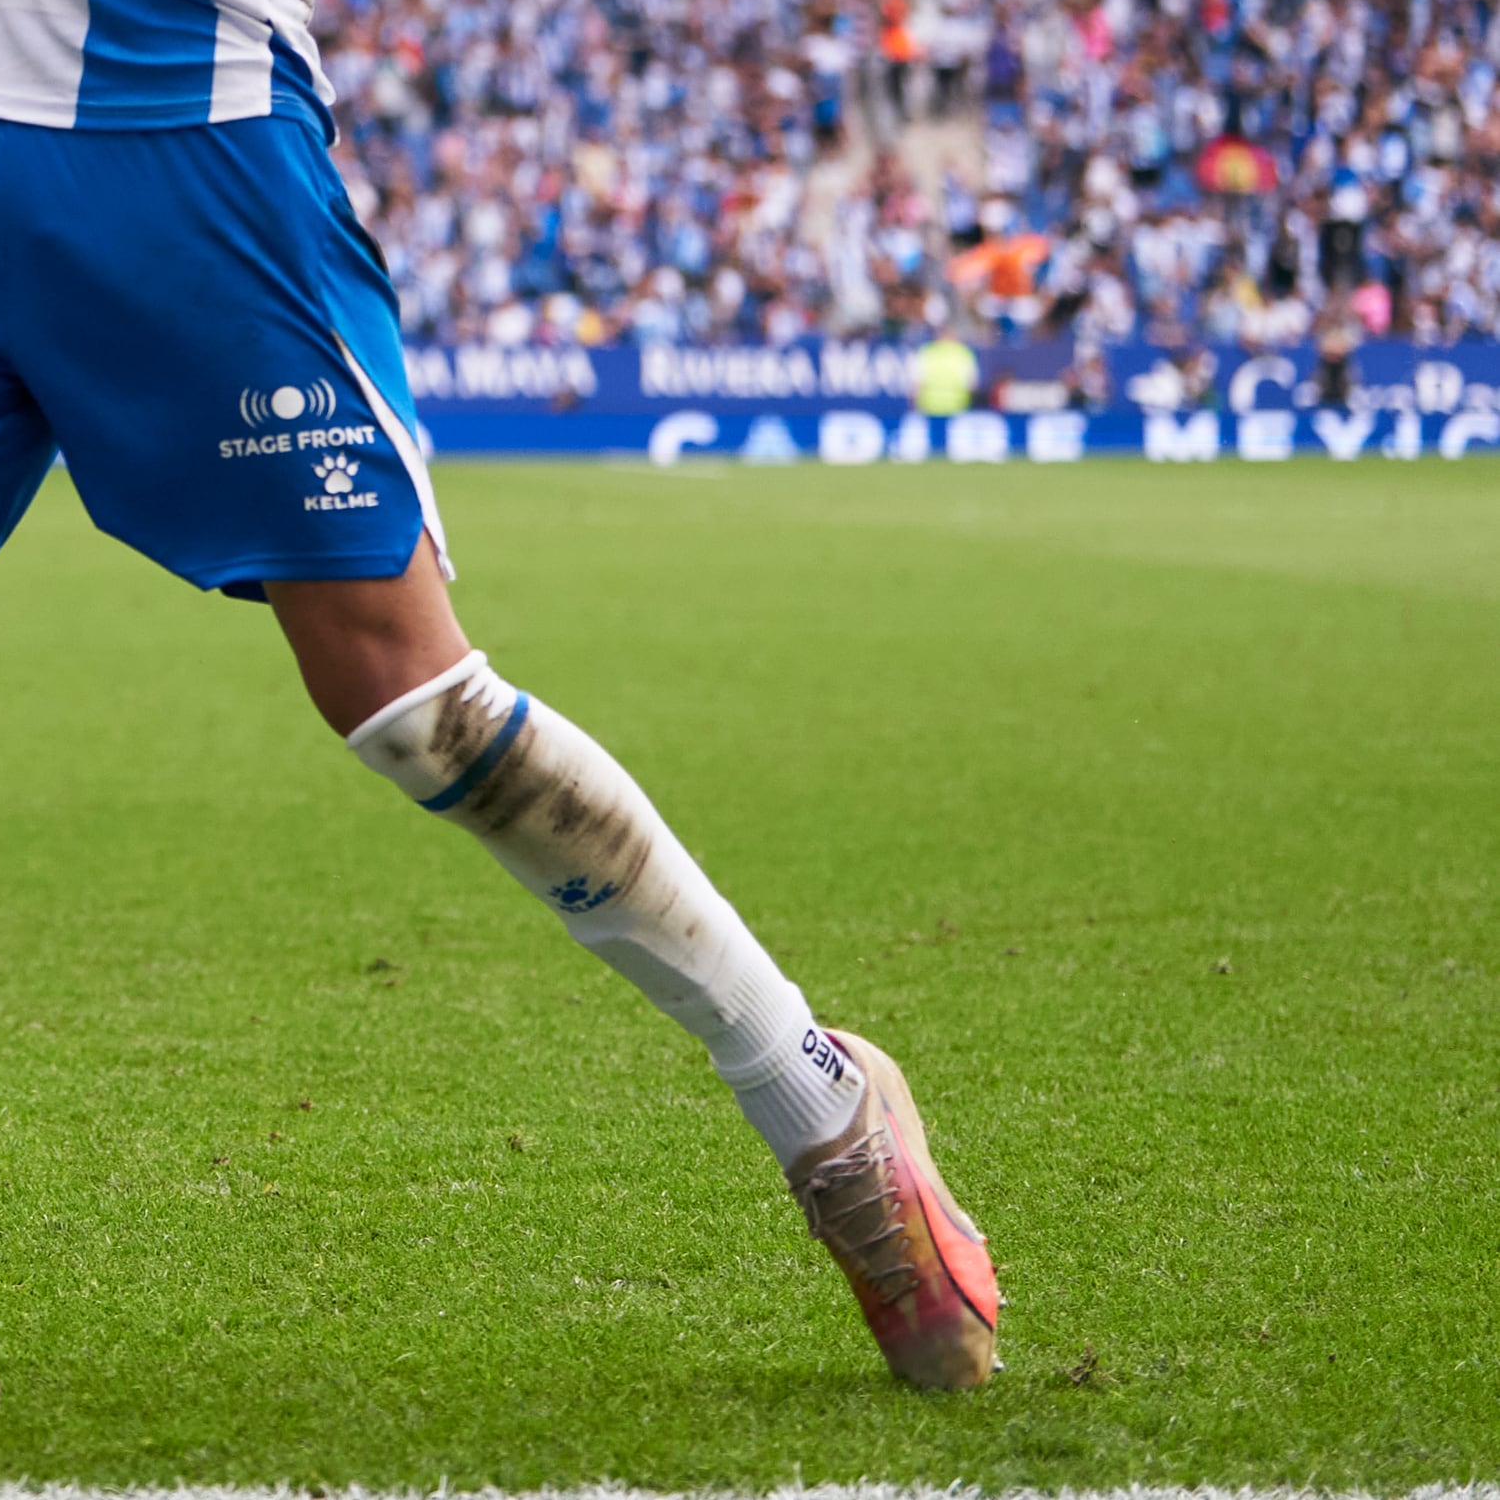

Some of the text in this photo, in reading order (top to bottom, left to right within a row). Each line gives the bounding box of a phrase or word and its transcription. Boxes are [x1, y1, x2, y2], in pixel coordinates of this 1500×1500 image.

[218, 425, 376, 459] STAGE FRONT
[303, 491, 380, 512] KELME
